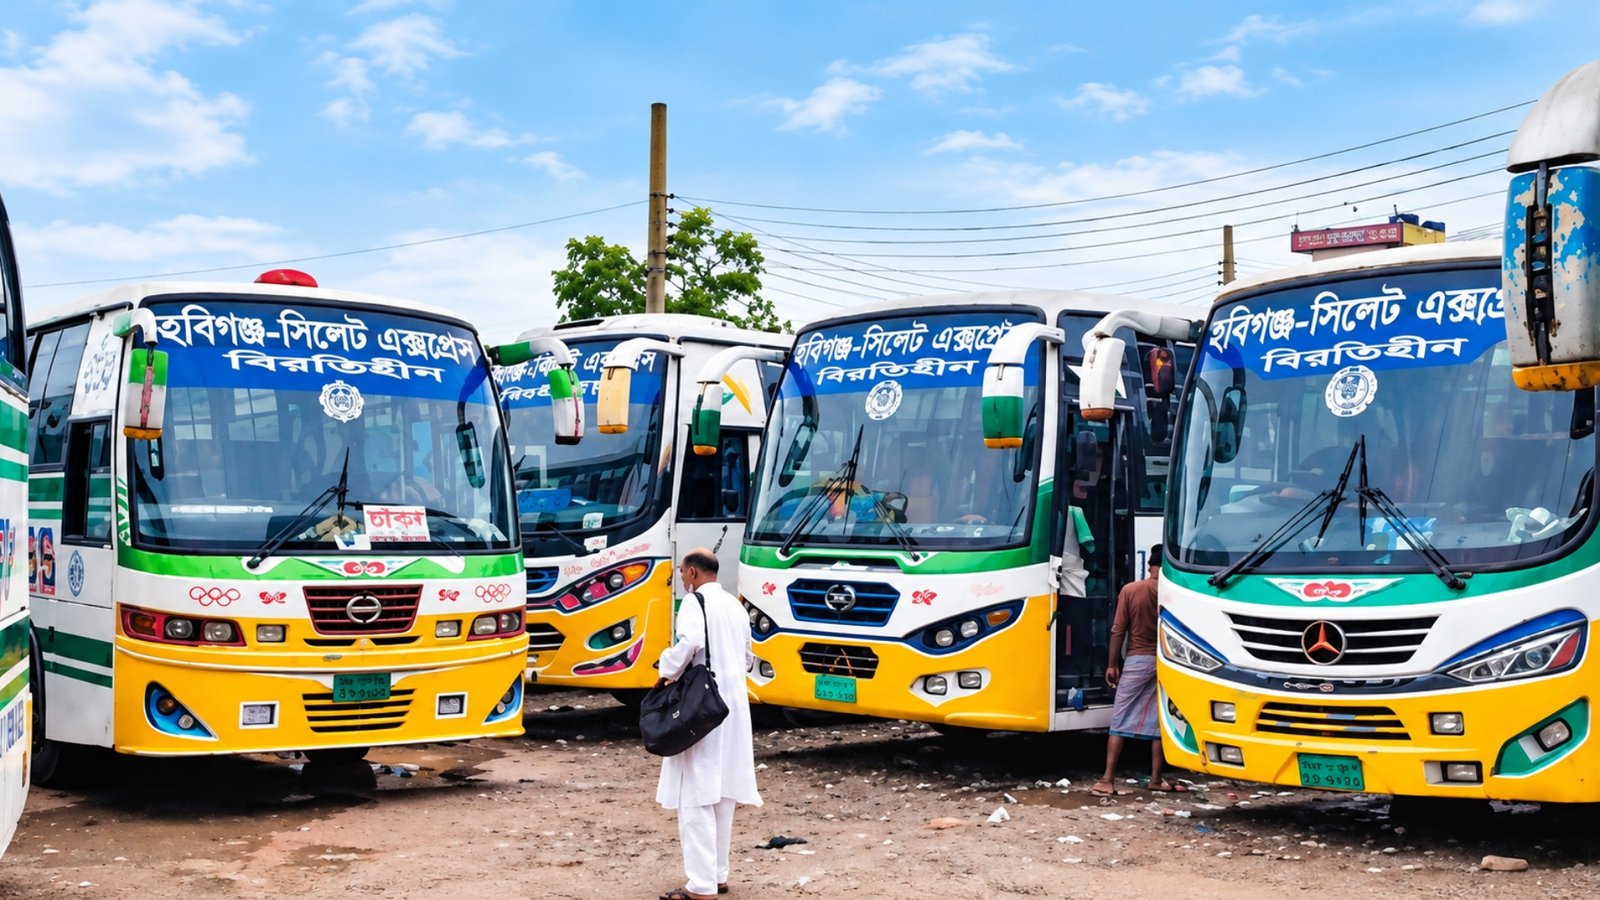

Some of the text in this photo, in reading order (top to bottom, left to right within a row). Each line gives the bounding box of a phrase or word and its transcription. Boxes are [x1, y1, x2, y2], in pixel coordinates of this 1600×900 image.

[223, 350, 444, 382] বিরতিহীন
[1261, 335, 1468, 372] বিরতিহীন
[817, 357, 979, 385] বিরতিহীন
